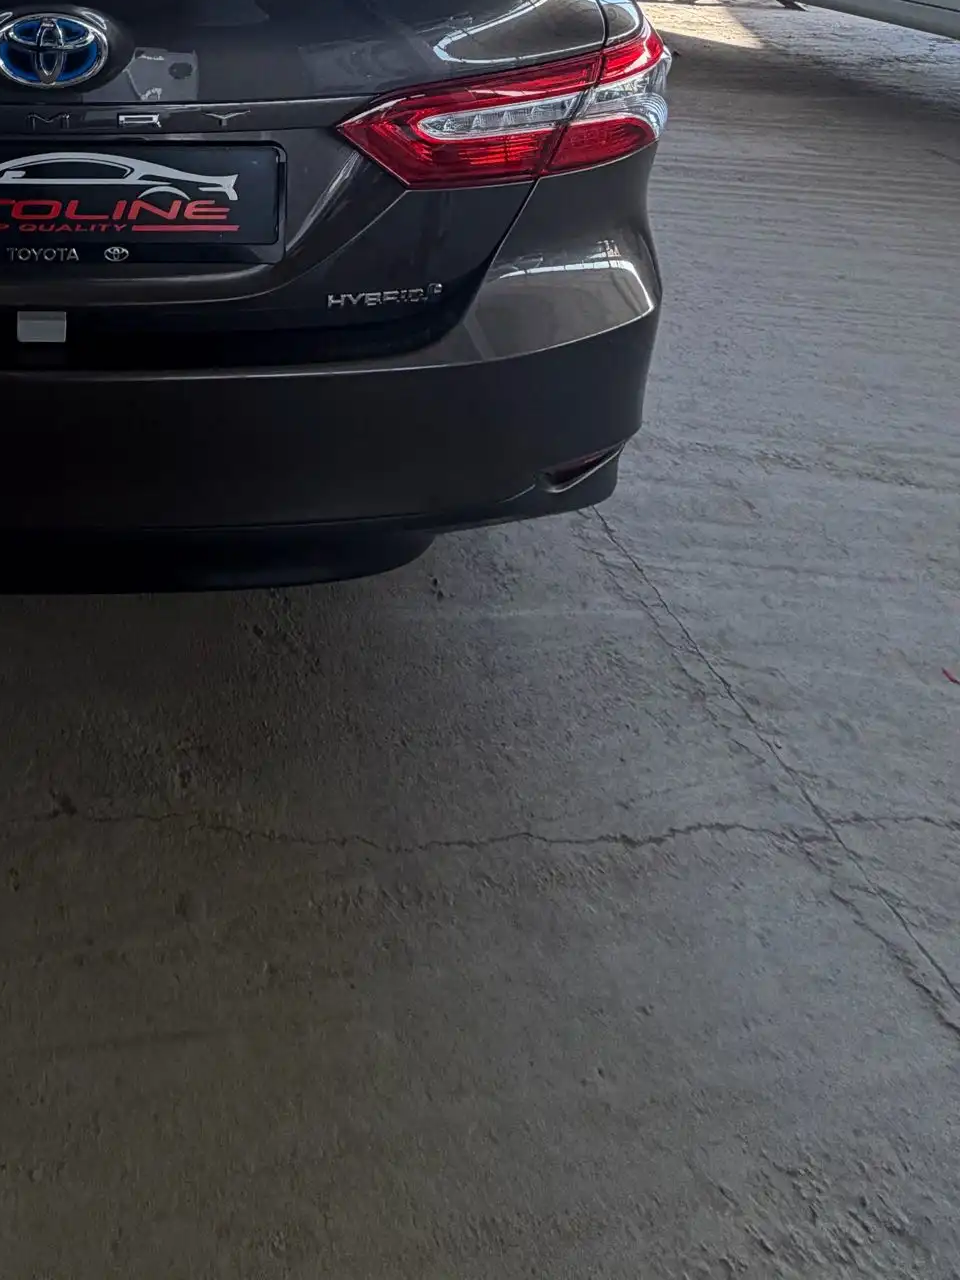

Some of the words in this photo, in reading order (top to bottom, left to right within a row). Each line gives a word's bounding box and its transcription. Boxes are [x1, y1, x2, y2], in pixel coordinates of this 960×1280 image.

[19, 223, 130, 233] QUALITY
[6, 246, 80, 262] TOYOTA
[327, 288, 427, 308] HYBRID
